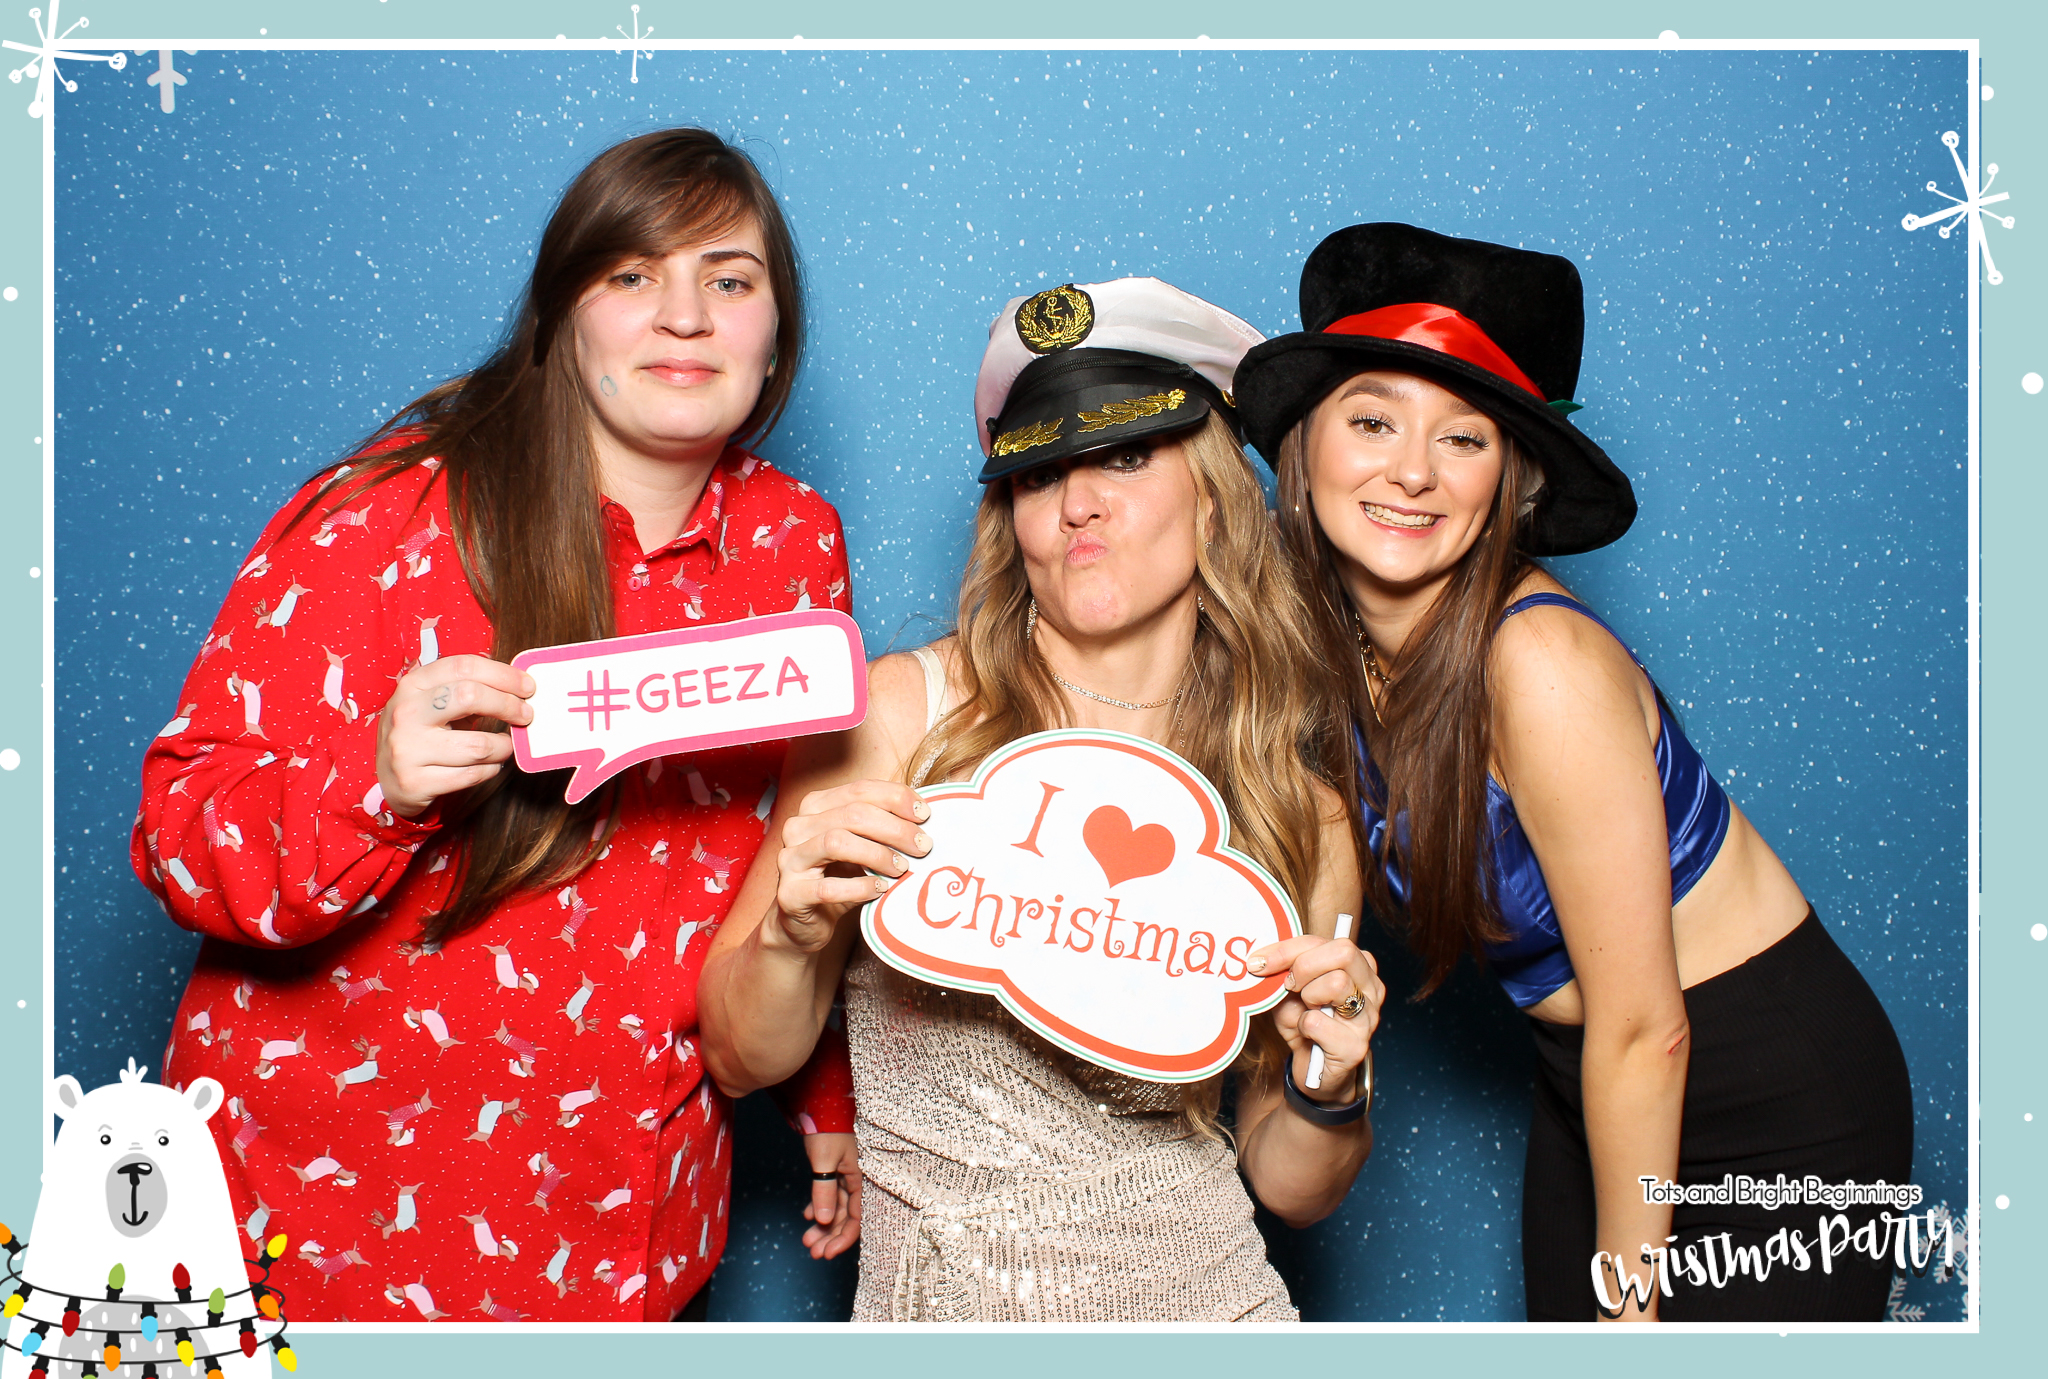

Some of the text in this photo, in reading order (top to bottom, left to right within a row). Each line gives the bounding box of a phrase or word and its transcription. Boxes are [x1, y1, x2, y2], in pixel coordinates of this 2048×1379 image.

[567, 656, 809, 731] #GEEZA
[1010, 780, 1065, 858] I
[916, 865, 1257, 982] Christmas
